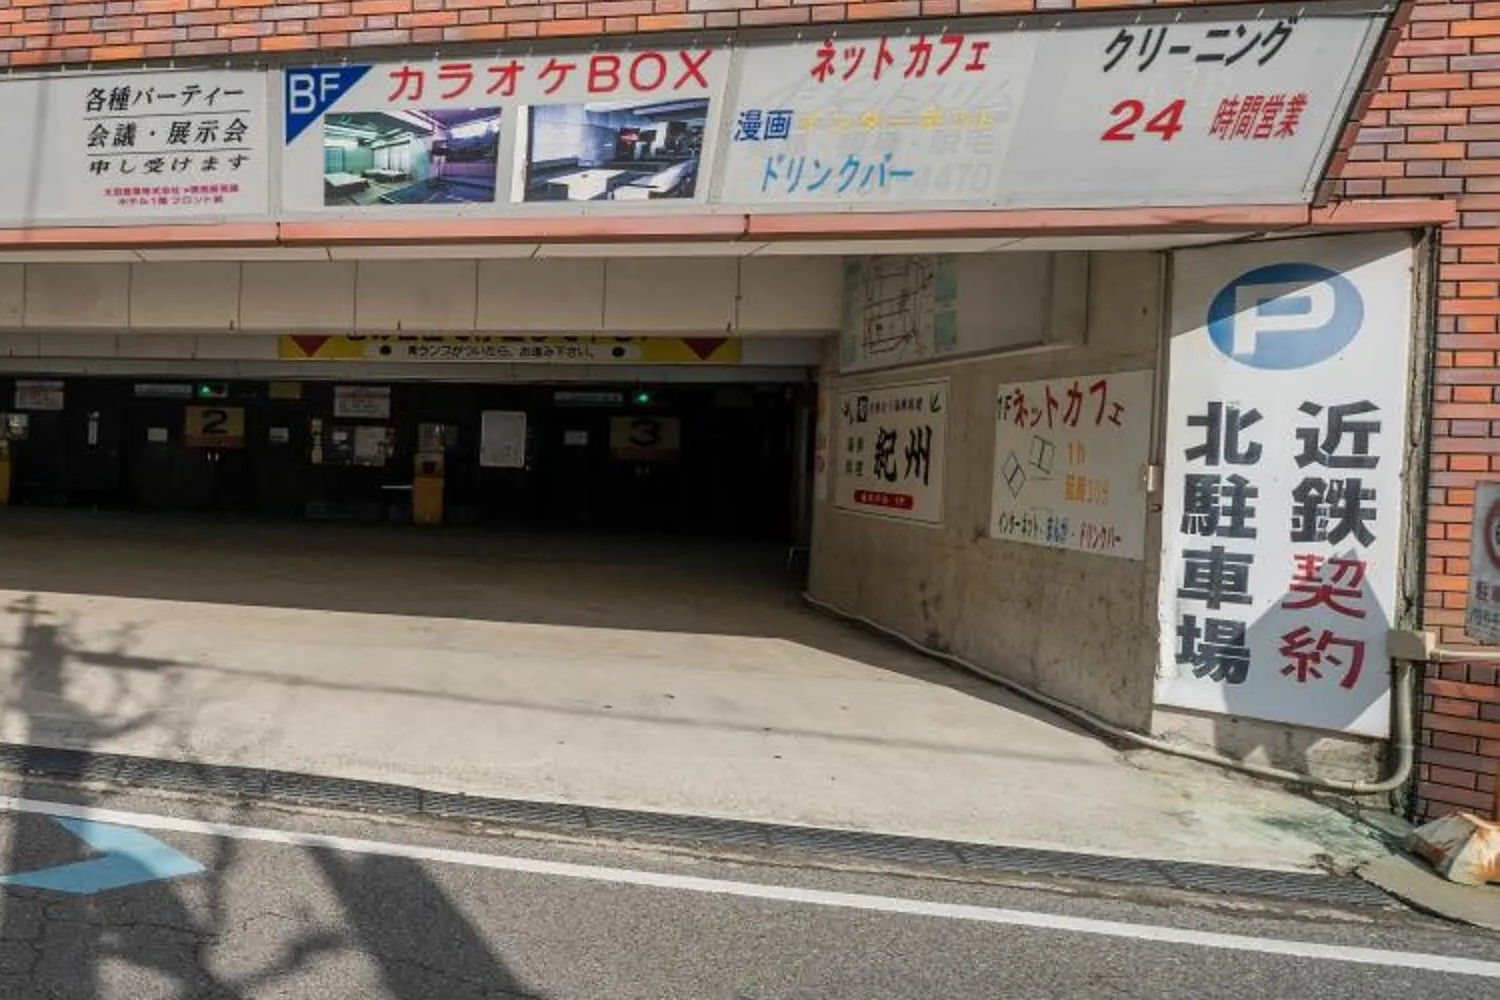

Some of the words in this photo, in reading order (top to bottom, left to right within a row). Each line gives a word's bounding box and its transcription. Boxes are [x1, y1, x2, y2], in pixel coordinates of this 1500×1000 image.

[811, 33, 990, 83] ネットカフェ
[1103, 18, 1299, 73] クリーニング
[288, 72, 341, 115] BF
[388, 49, 713, 102] カラオケBOX
[86, 85, 244, 112] 各種パーティー
[1101, 99, 1186, 142] 24
[87, 117, 249, 148] 会議・展示会
[89, 154, 249, 175] 申し受けます
[761, 152, 915, 194] ドリンクバー
[1233, 282, 1334, 356] P
[201, 410, 229, 434] 2
[1014, 380, 1125, 428] ネットカフェ
[628, 419, 662, 447] 3
[874, 423, 932, 487] 紀州
[1176, 401, 1264, 686] 北駐車場
[1277, 399, 1382, 691] 近鉄契約
